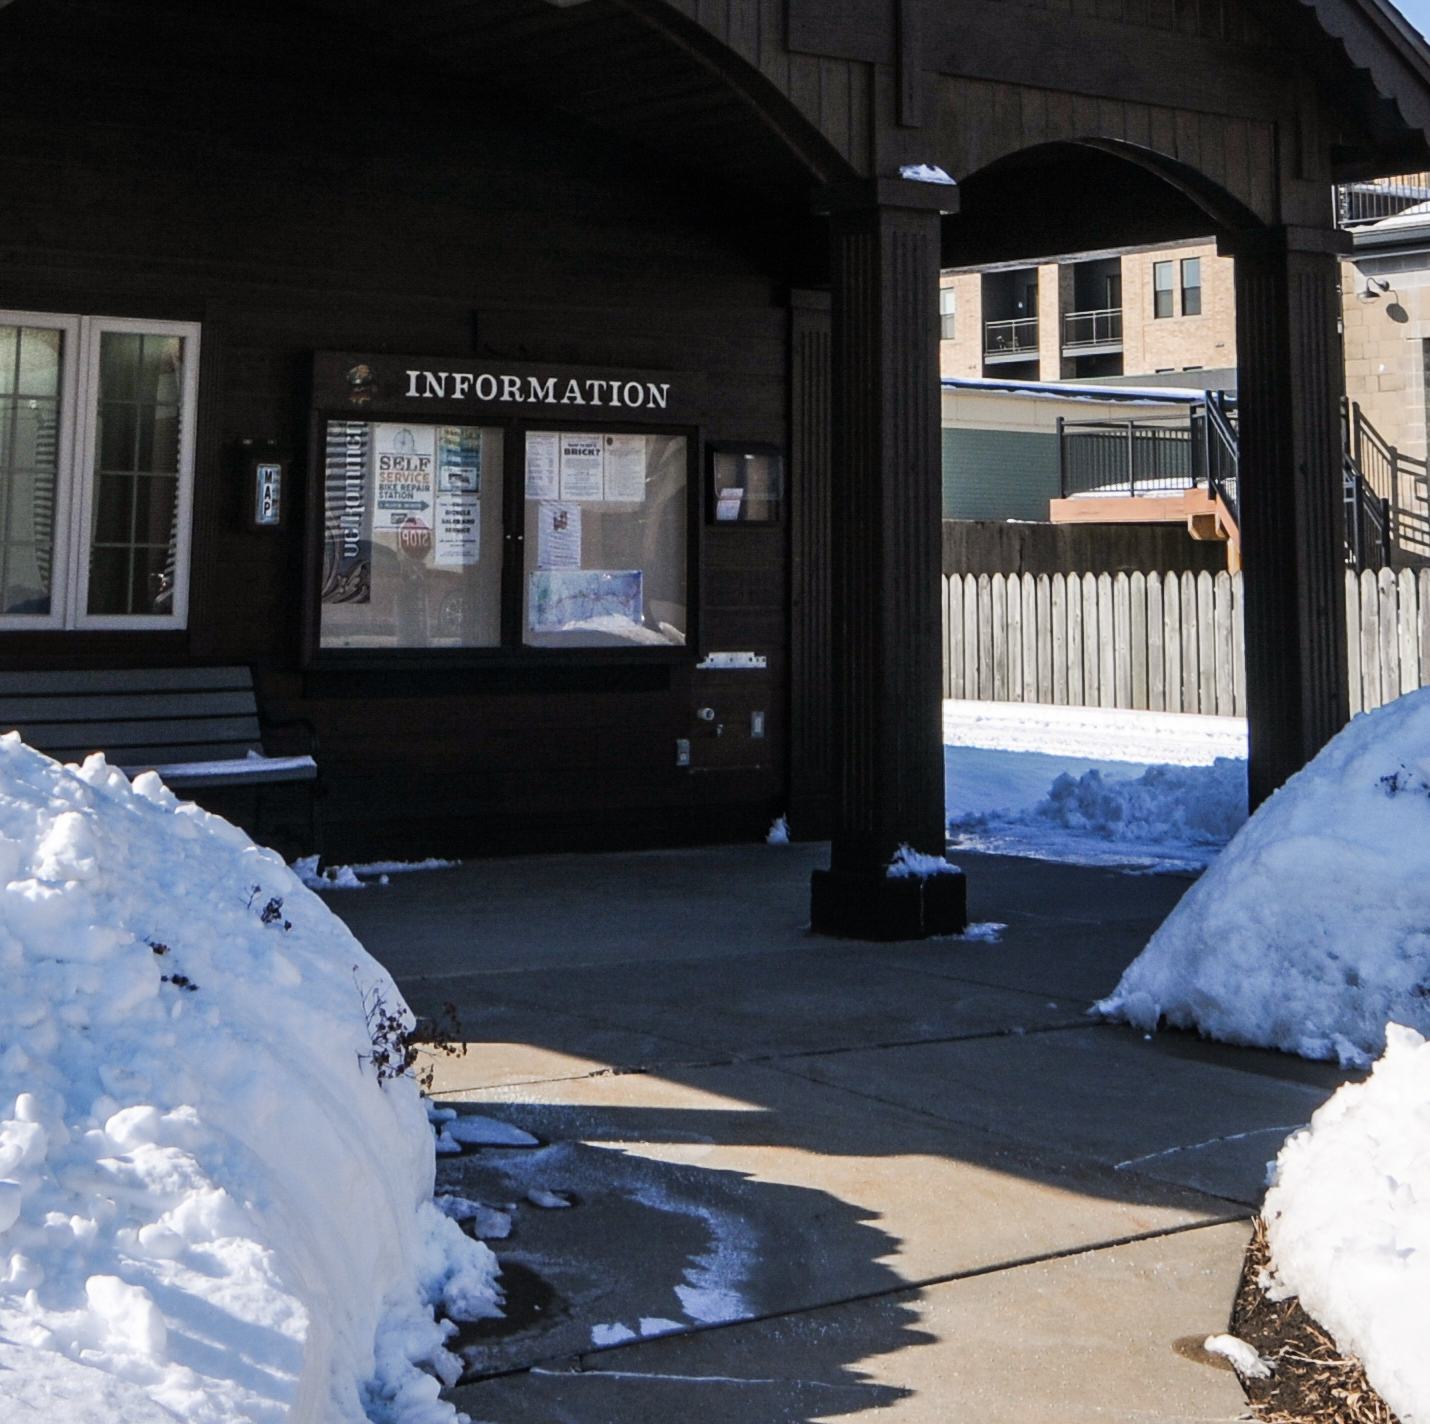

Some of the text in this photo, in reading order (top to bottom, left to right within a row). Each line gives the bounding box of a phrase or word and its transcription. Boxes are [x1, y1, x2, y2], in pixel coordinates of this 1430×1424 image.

[405, 370, 671, 410] INFORMATION
[563, 447, 601, 456] BRICK?
[379, 455, 431, 472] SELF
[378, 471, 430, 484] SERVICE
[263, 469, 274, 516] MAP
[378, 483, 431, 493] BIKE REPAIR
[378, 491, 414, 500] STATION
